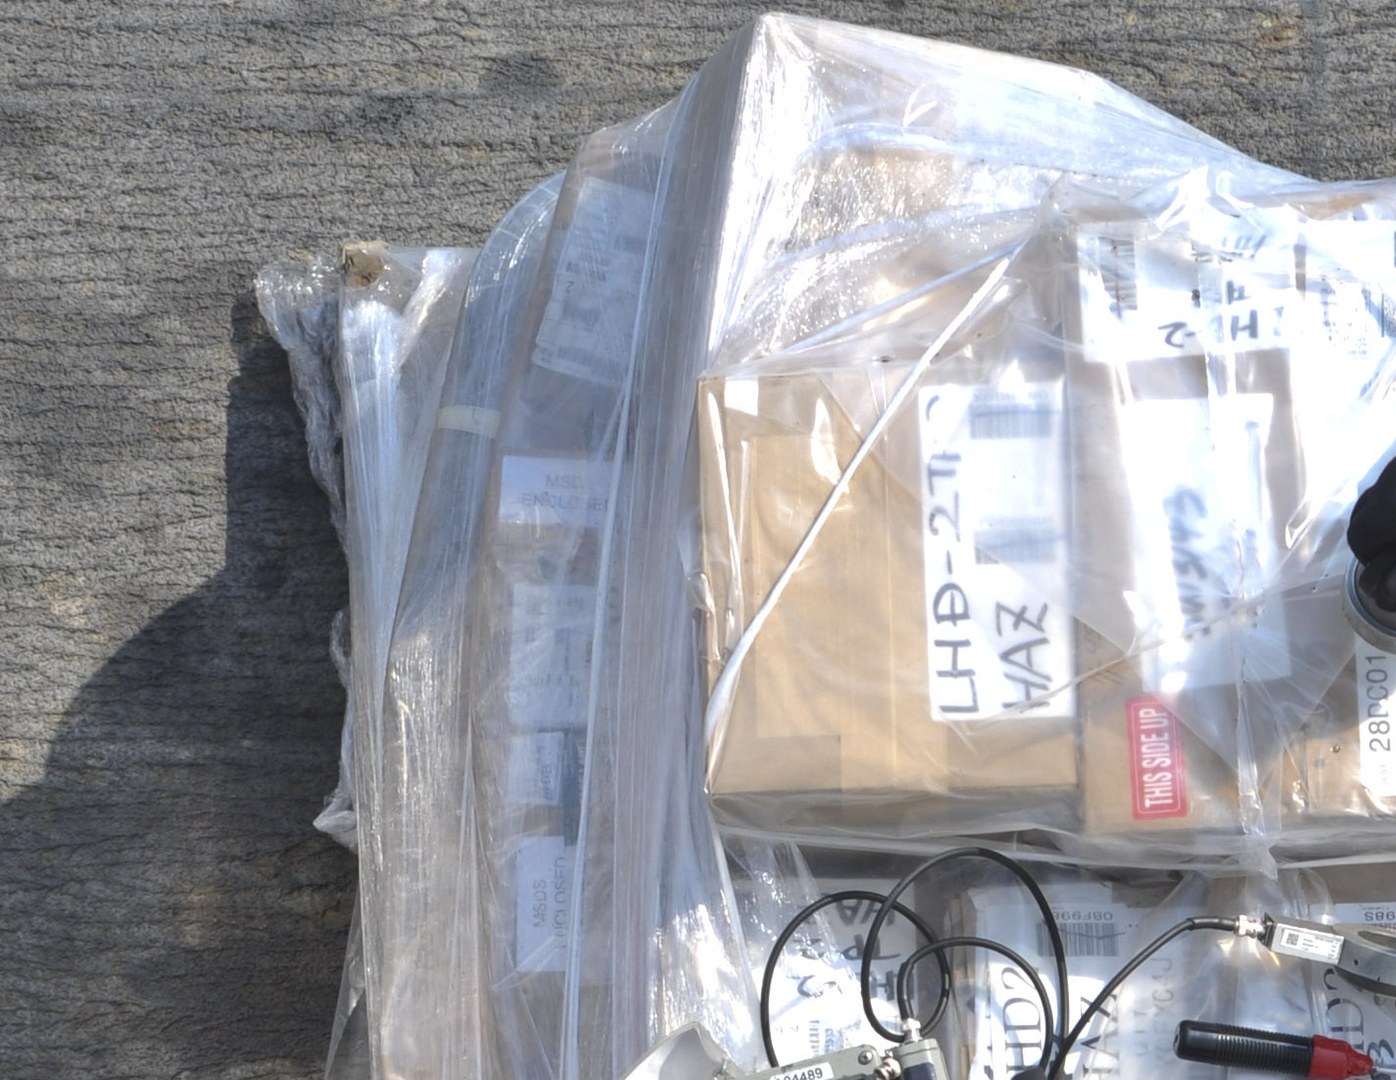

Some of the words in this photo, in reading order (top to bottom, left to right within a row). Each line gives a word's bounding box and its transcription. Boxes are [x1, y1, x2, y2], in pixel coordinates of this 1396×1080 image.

[994, 601, 1054, 710] HAZ
[1138, 708, 1169, 730] UP
[1140, 732, 1172, 768] SIDE
[1142, 771, 1174, 808] THIS
[1001, 967, 1042, 1073] HD2
